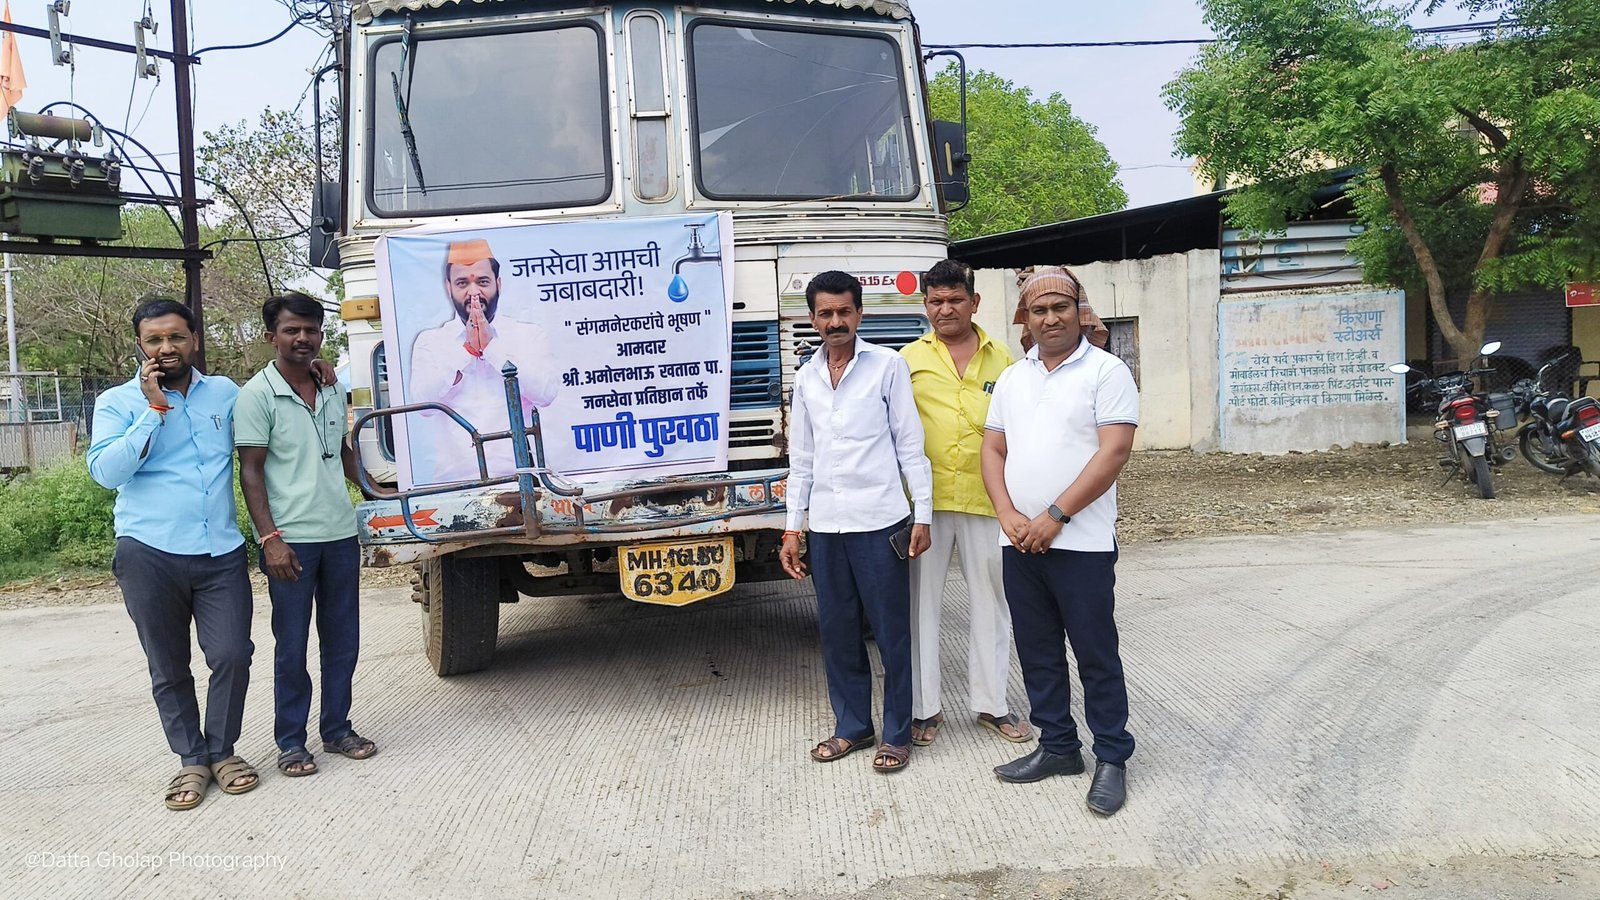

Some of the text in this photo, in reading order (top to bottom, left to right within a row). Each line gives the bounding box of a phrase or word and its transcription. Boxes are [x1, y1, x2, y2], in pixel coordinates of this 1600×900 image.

[509, 241, 661, 277] जनसेवा आमची
[537, 270, 644, 302] जबाबदारी!
[576, 311, 664, 335] संगमनेरकरांचे
[667, 312, 701, 332] भूषण
[1336, 308, 1385, 325] किराणा
[616, 340, 667, 357] आमदार
[704, 360, 723, 374] पा.
[581, 381, 708, 410] जनसेवा प्रतिष्ठान तर्फे
[571, 412, 720, 457] पाणी पुरवठा
[634, 568, 721, 597] 6340
